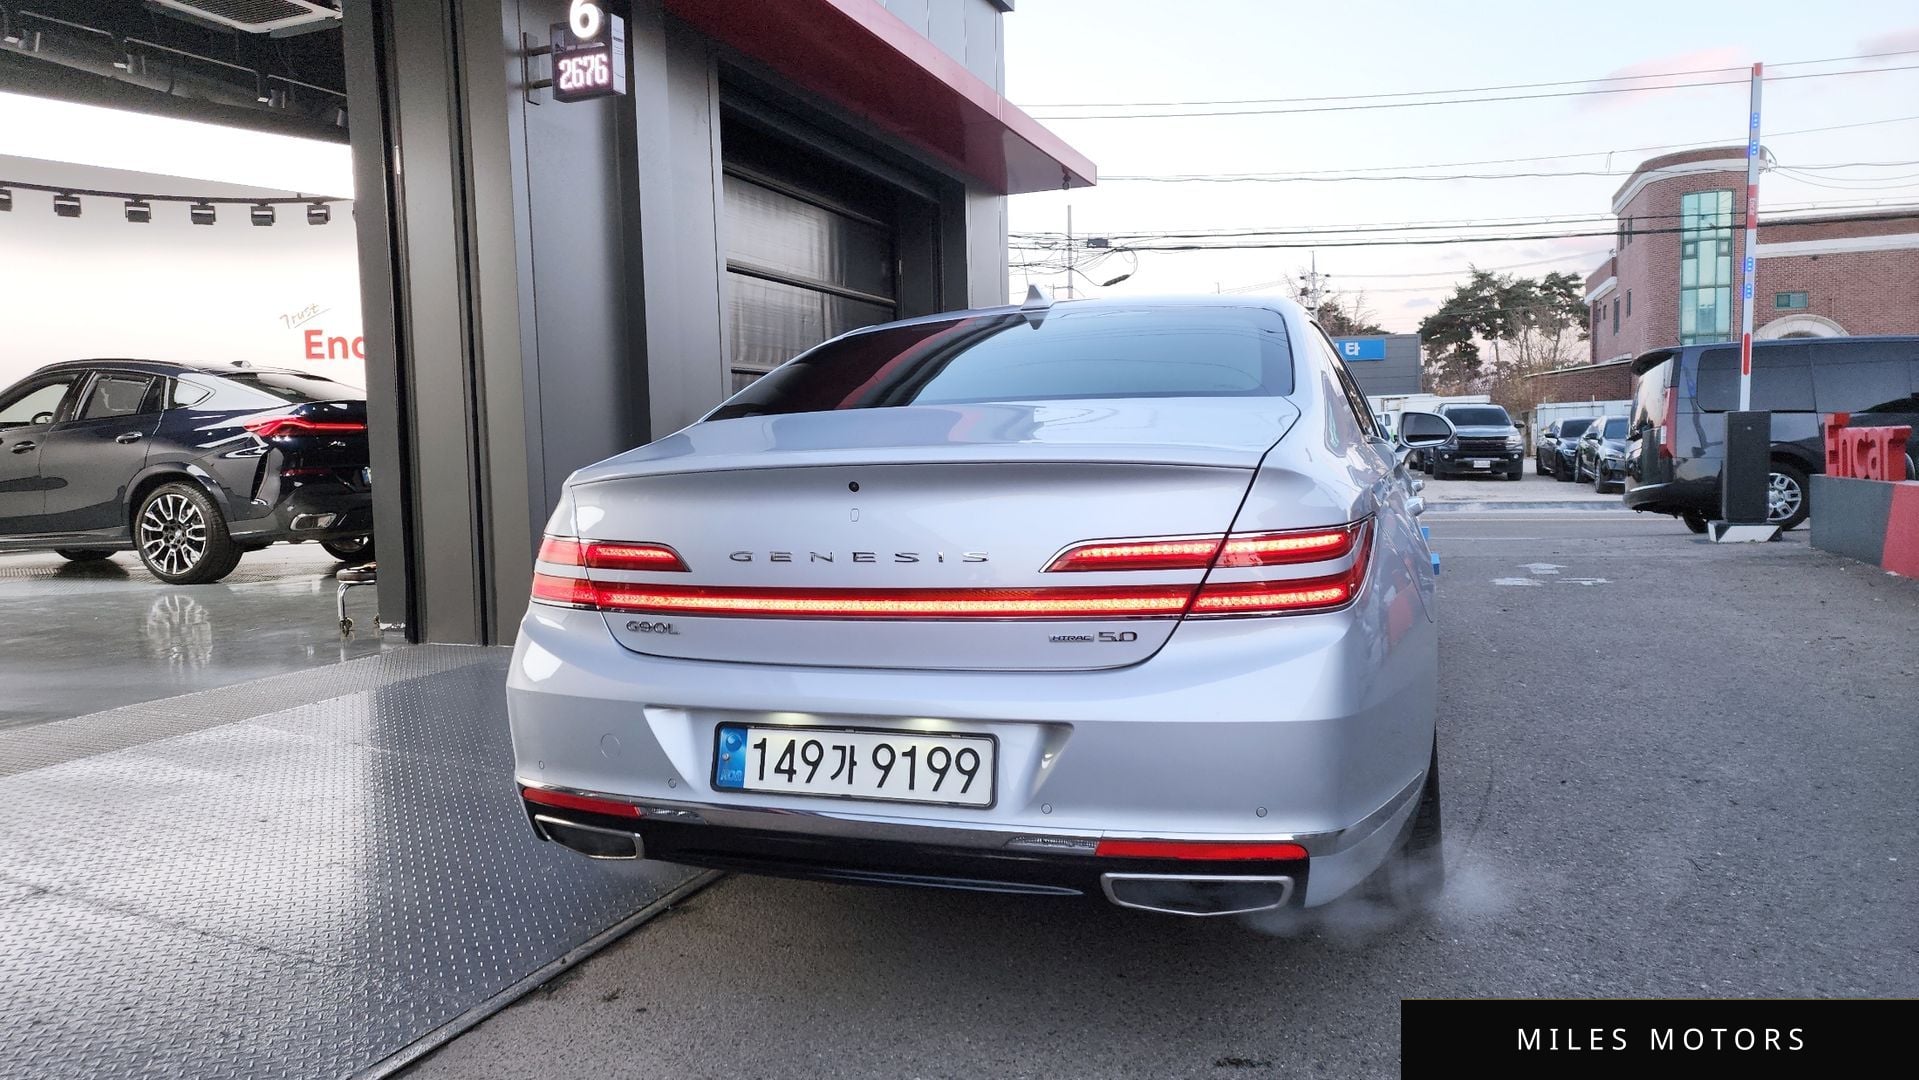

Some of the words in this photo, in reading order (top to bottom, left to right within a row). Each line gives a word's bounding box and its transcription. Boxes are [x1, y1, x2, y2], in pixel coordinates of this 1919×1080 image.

[570, 0, 600, 38] 6
[558, 54, 609, 90] 2676
[280, 303, 320, 329] Trust
[1335, 342, 1360, 356] 타
[1824, 413, 1908, 481] Encar
[729, 551, 989, 563] GENESIS
[626, 620, 681, 635] G90L
[1098, 631, 1138, 642] 5.0
[753, 737, 857, 785] 149가
[872, 743, 980, 794] 9199
